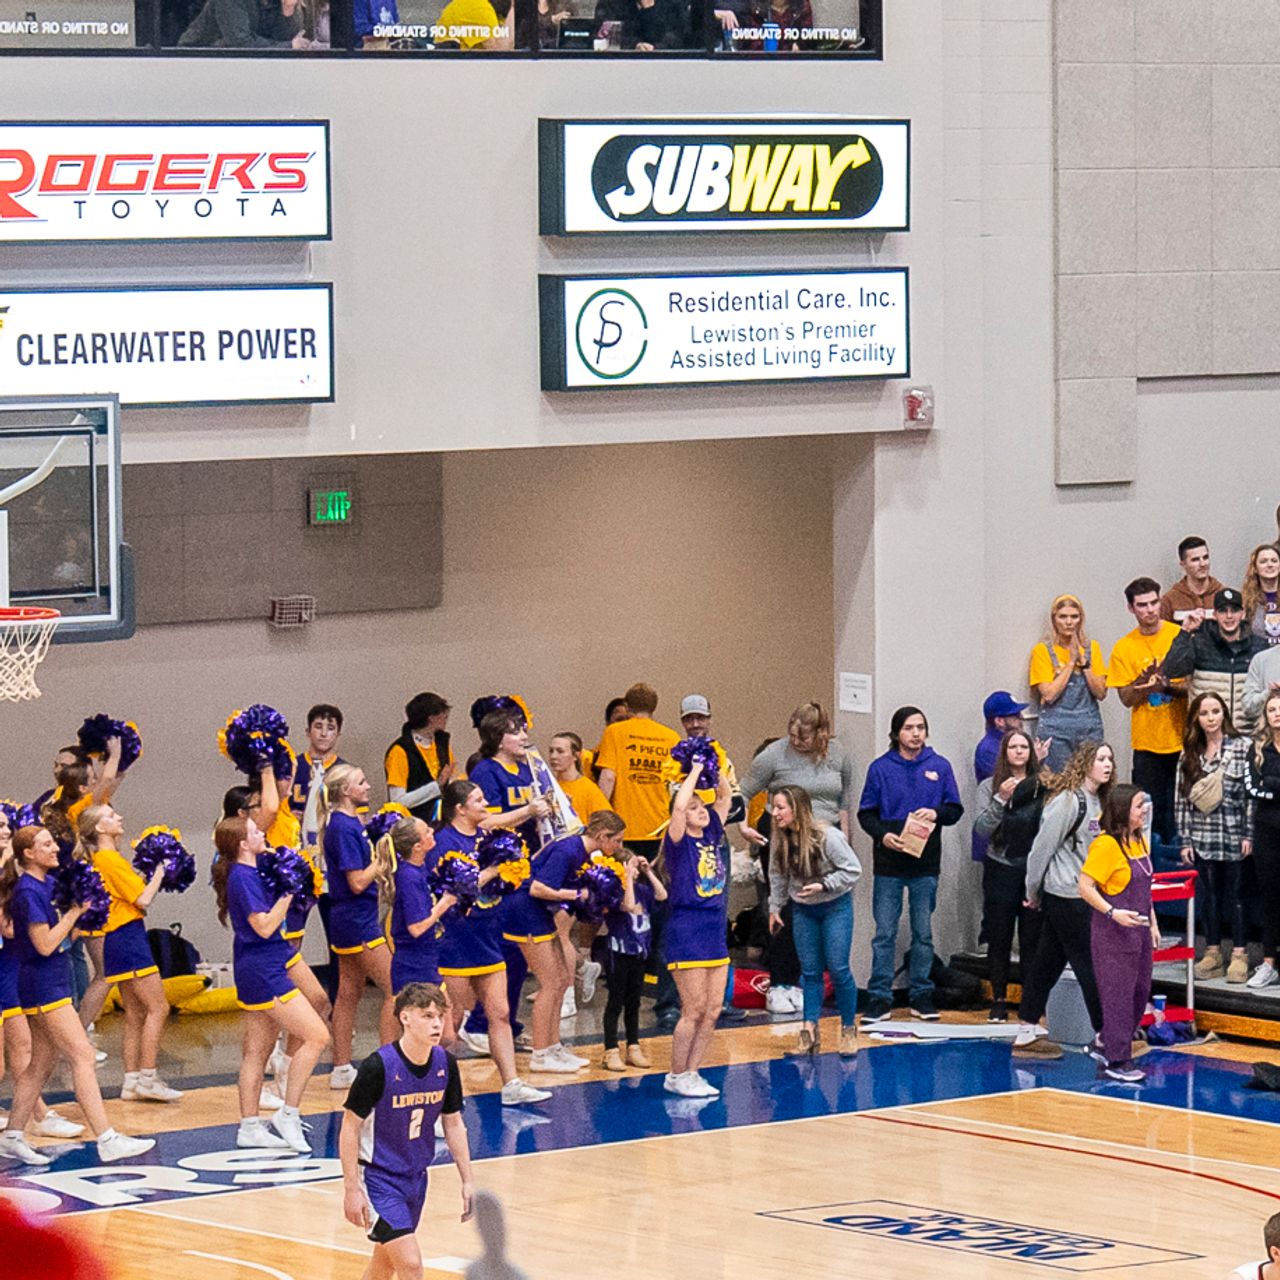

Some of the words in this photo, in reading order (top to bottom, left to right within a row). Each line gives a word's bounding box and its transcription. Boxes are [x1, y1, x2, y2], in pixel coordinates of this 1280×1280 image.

[0, 149, 316, 220] ROGERS
[605, 137, 871, 218] SUBWAY
[73, 198, 287, 219] TOYOTA
[669, 290, 789, 314] Residential
[860, 288, 896, 309] Inc.
[16, 331, 206, 366] CLEARWATER
[218, 328, 317, 360] POWER
[691, 322, 795, 345] Lewiston's
[803, 320, 877, 341] Premier
[670, 347, 756, 369] Assisted
[763, 347, 822, 369] Living
[829, 344, 896, 367] Facility
[314, 490, 351, 520] EXIT
[408, 1108, 424, 1140] 2
[822, 1213, 1098, 1262] INLAND
